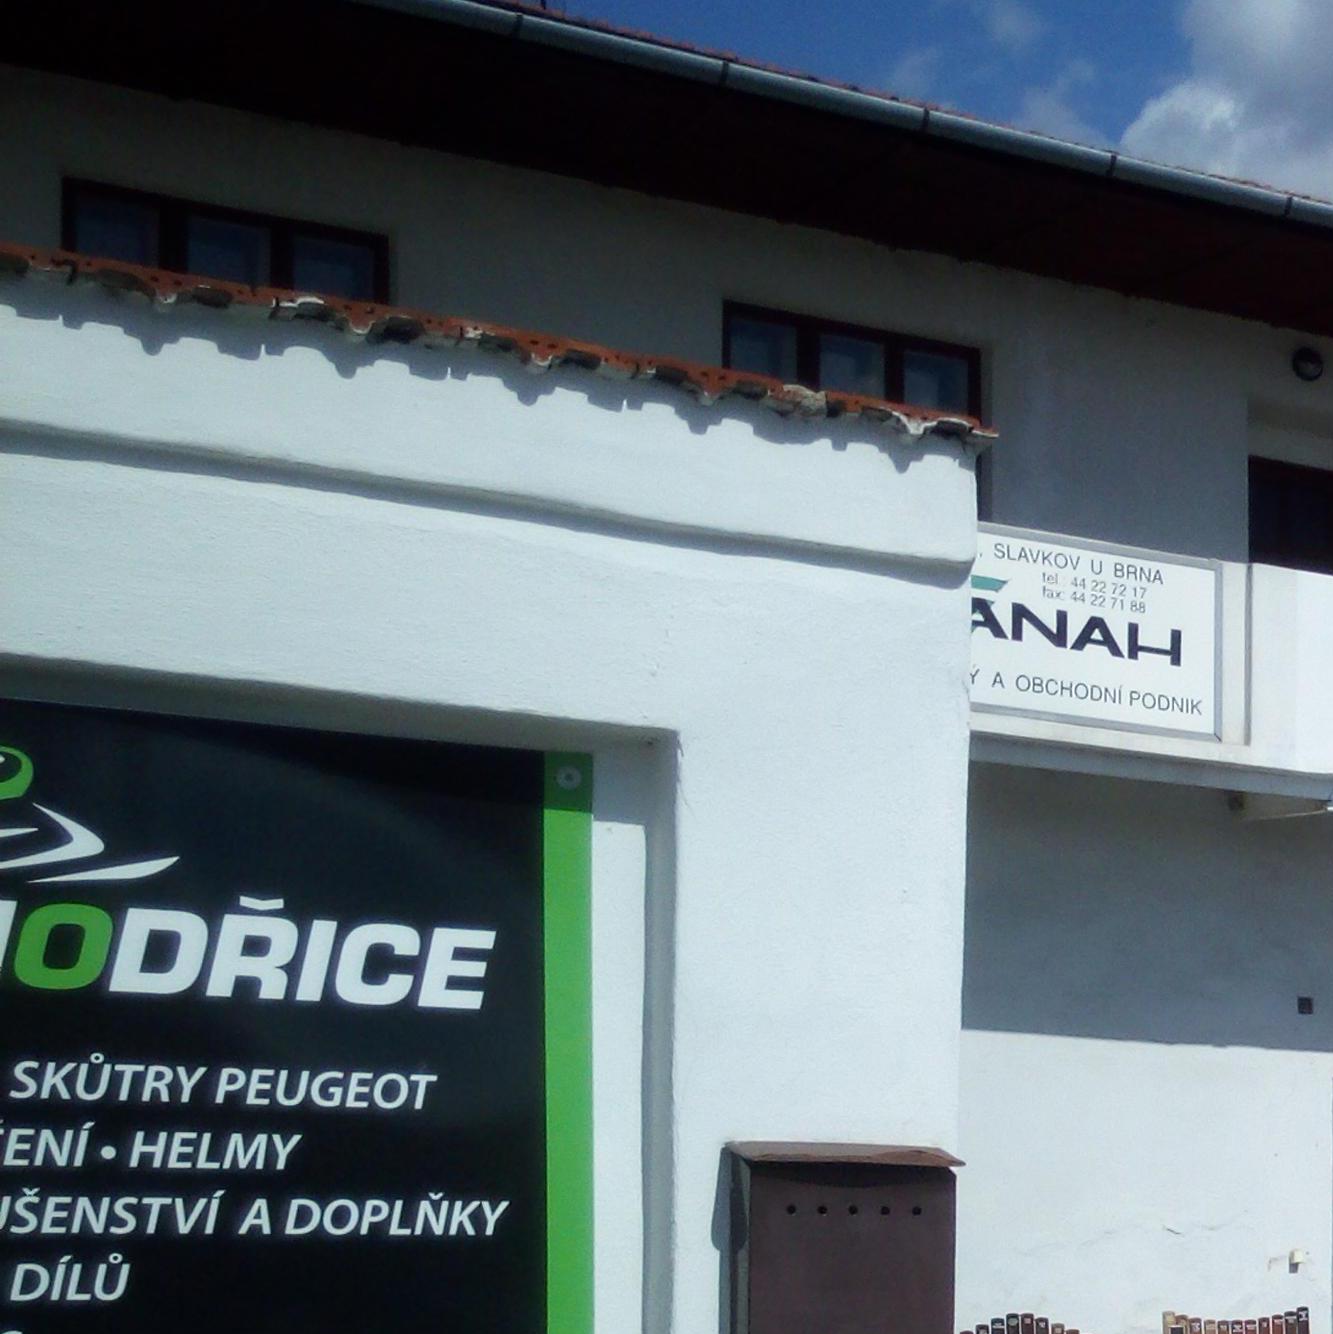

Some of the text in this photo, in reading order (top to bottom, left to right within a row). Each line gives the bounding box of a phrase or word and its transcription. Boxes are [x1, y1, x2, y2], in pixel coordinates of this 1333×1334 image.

[993, 543, 1164, 585] SLAVKOV U BRNA
[1070, 577, 1086, 590] 44
[1090, 580, 1106, 594] 22
[1111, 583, 1127, 597] 72
[1132, 586, 1147, 599] 17
[1070, 590, 1086, 604] 44
[1090, 594, 1107, 608] 22
[1111, 597, 1125, 611] 71
[1130, 600, 1146, 614] 88
[992, 672, 1005, 688] A
[1015, 673, 1122, 705] OBCHODNÍ
[1129, 690, 1203, 716] PODNIK
[0, 895, 497, 1010] ODŘICE
[9, 1052, 437, 1111] SKŮTRY PEUGEOT
[0, 1119, 303, 1170] ENÍ HELMY
[238, 1195, 273, 1236] A
[284, 1191, 510, 1238] DOPLŇKY
[10, 1253, 130, 1301] DÍLŮ
